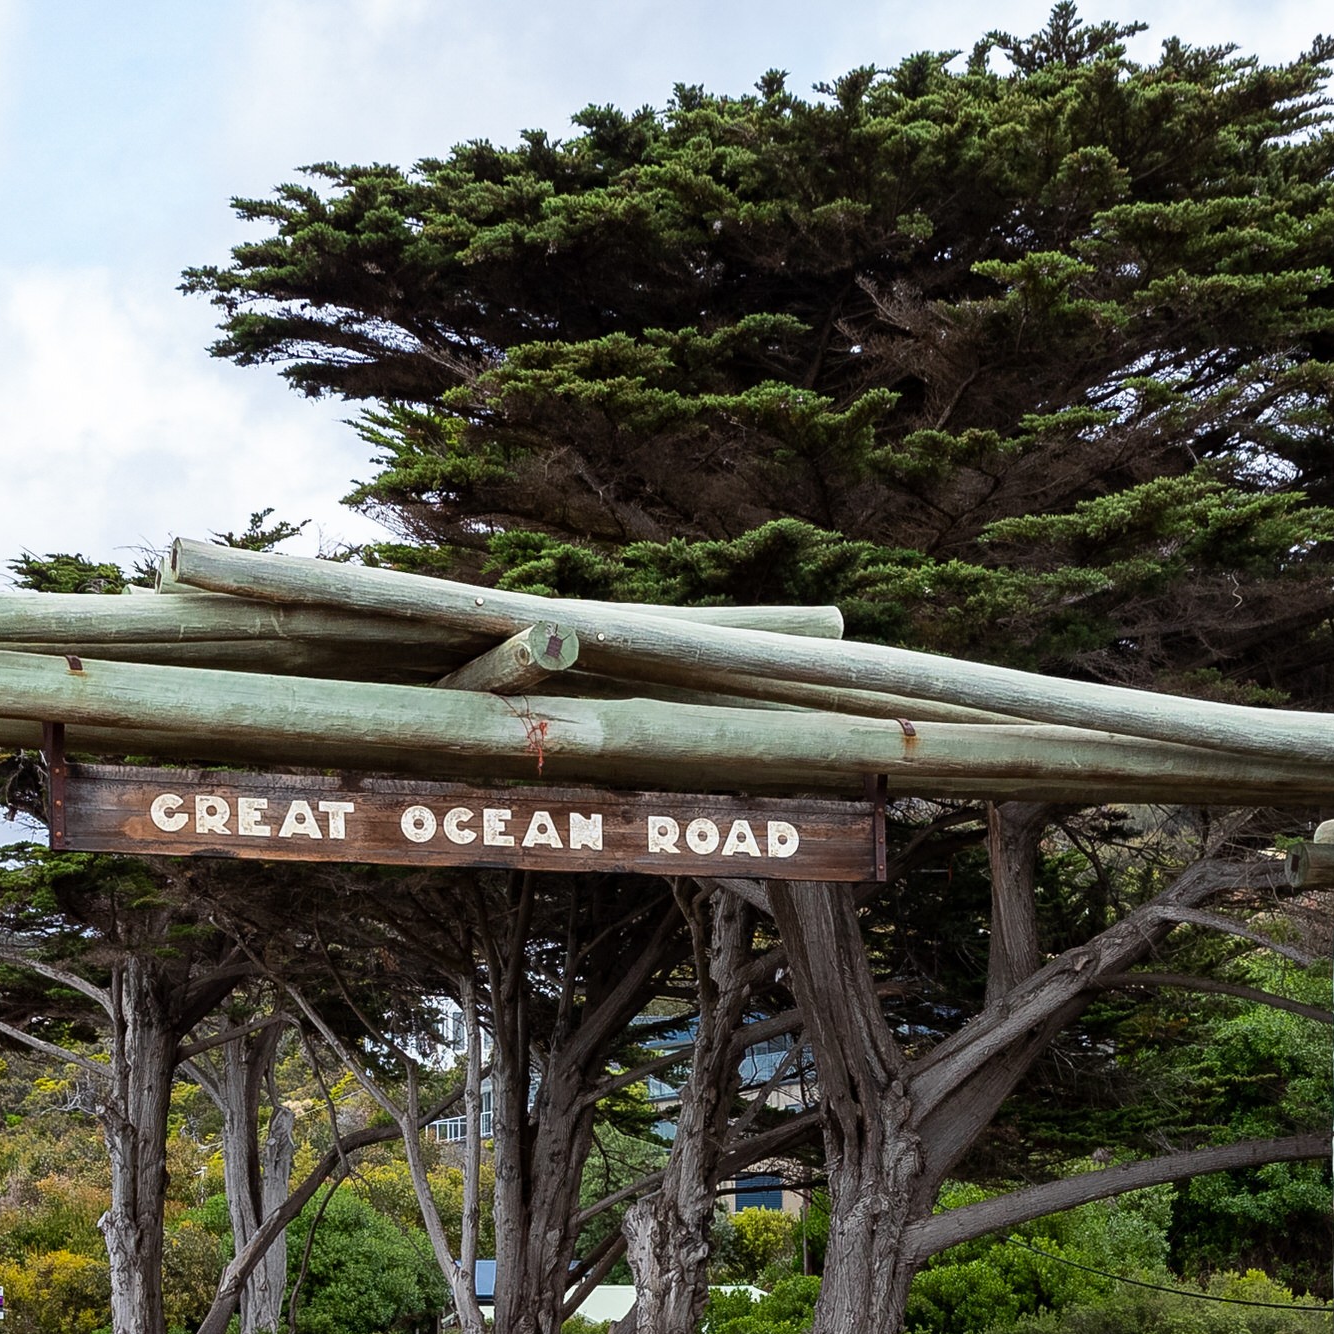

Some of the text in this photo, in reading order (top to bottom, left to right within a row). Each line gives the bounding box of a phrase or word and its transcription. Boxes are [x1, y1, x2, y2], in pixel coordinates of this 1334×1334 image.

[149, 792, 800, 858] GREAT OCEAN ROAD
